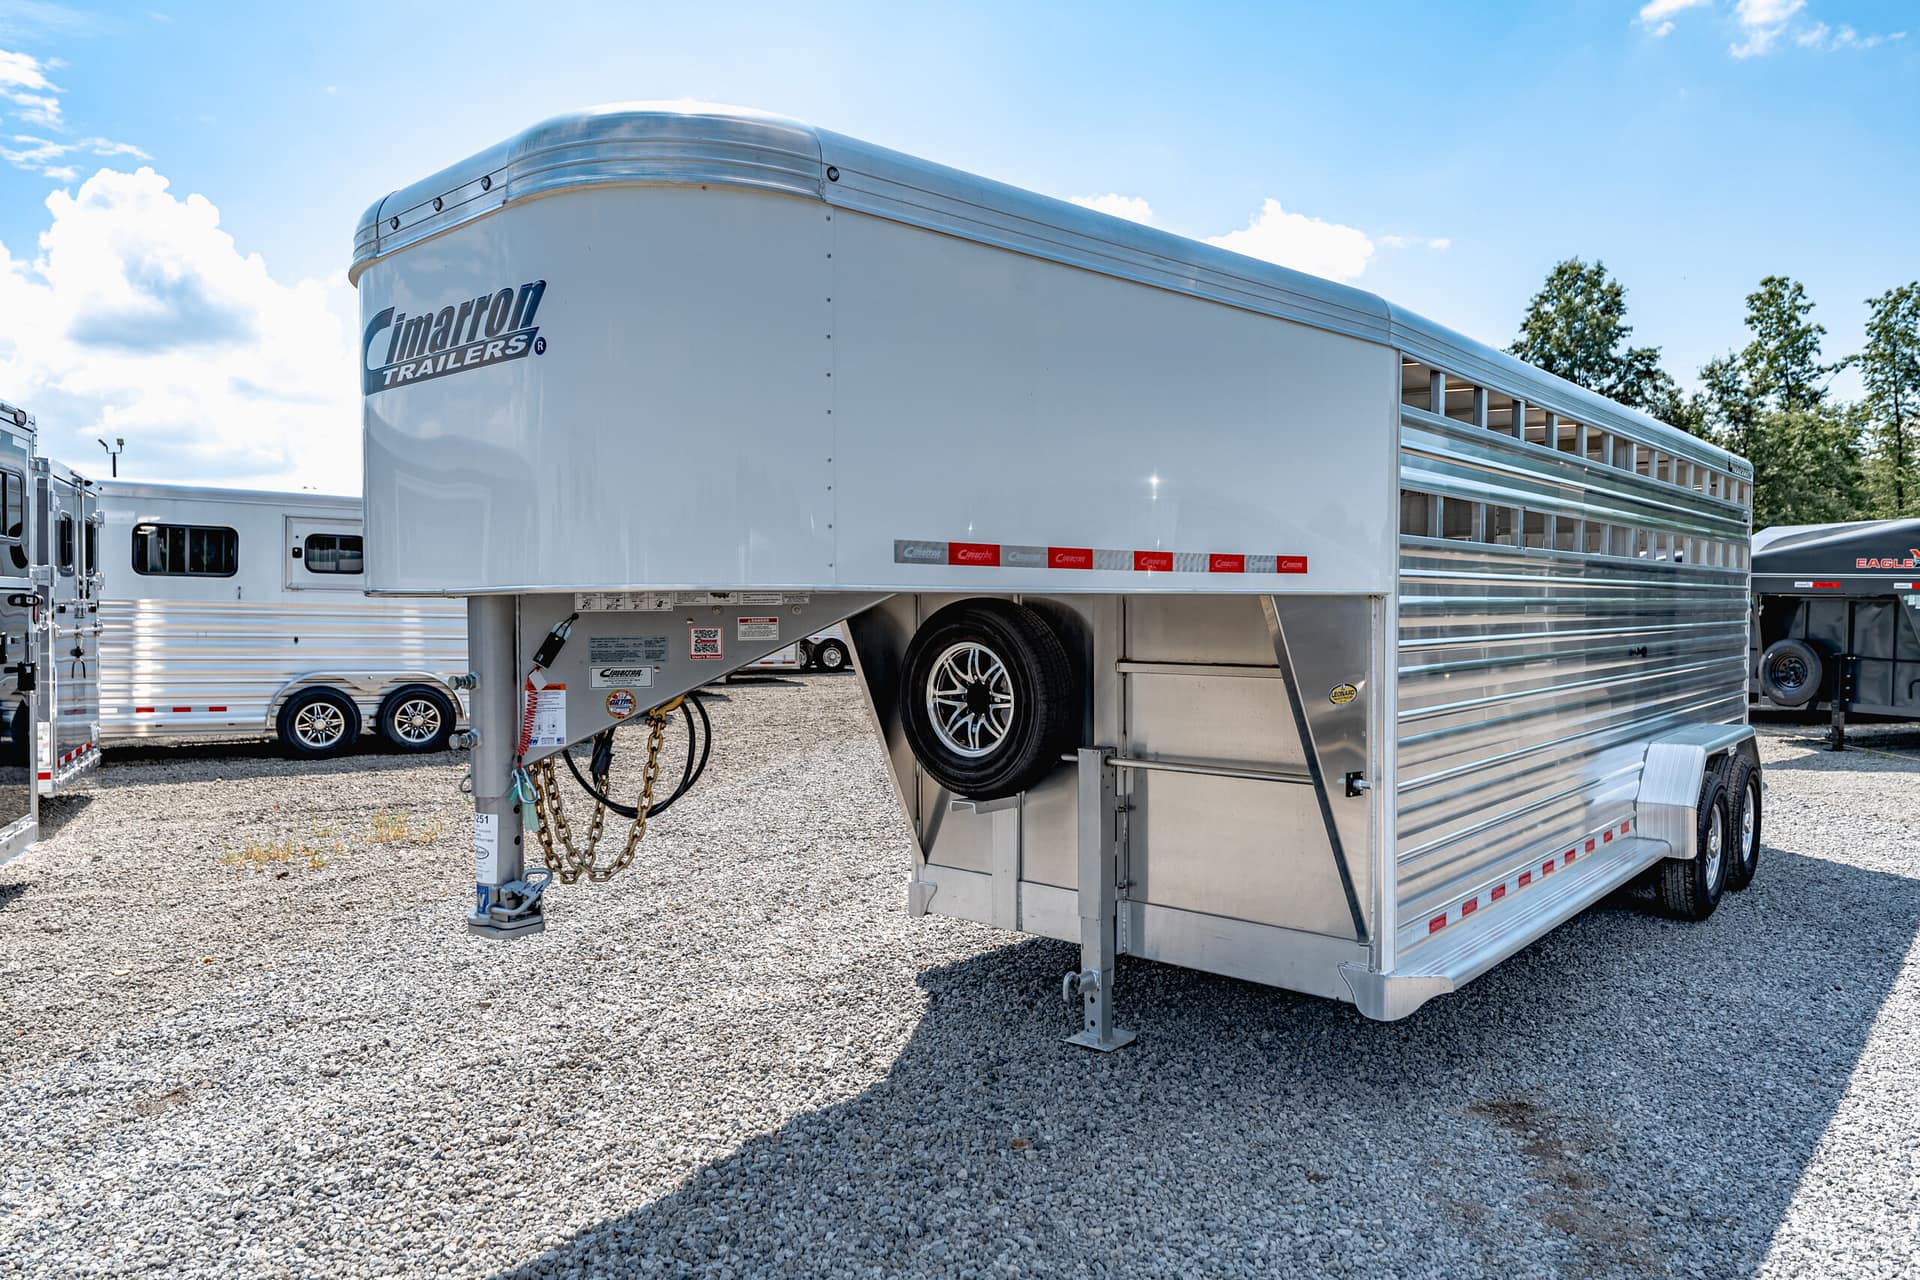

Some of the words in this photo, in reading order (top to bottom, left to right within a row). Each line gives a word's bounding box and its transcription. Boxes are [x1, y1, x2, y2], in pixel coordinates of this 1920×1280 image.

[364, 279, 547, 372] Cimarron
[382, 334, 528, 386] TRAILERS
[1856, 558, 1914, 569] EAGLE
[599, 668, 642, 678] Cimarron
